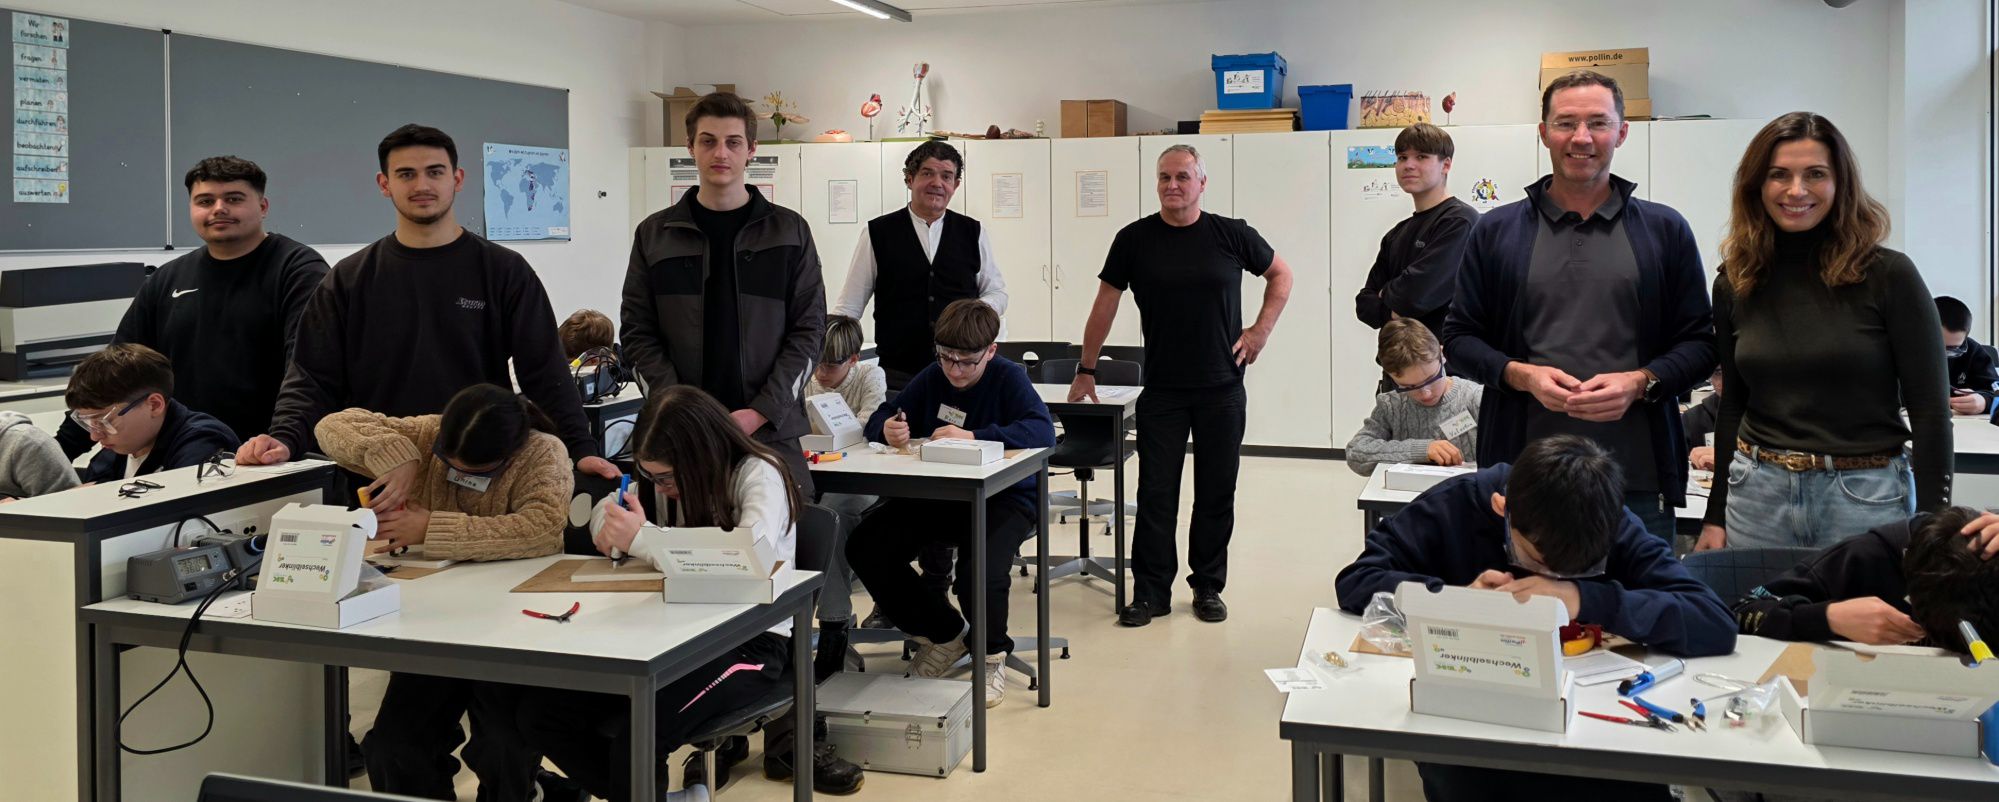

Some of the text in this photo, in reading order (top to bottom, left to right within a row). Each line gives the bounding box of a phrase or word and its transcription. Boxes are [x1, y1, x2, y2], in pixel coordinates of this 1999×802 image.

[28, 19, 39, 28] Wir
[20, 30, 47, 40] forschen
[20, 53, 42, 63] fragen
[1568, 53, 1623, 62] www.pollin.de
[18, 189, 51, 197] auswerten
[278, 562, 327, 573] Wechselblinker
[1440, 653, 1522, 669] Wechselblinker
